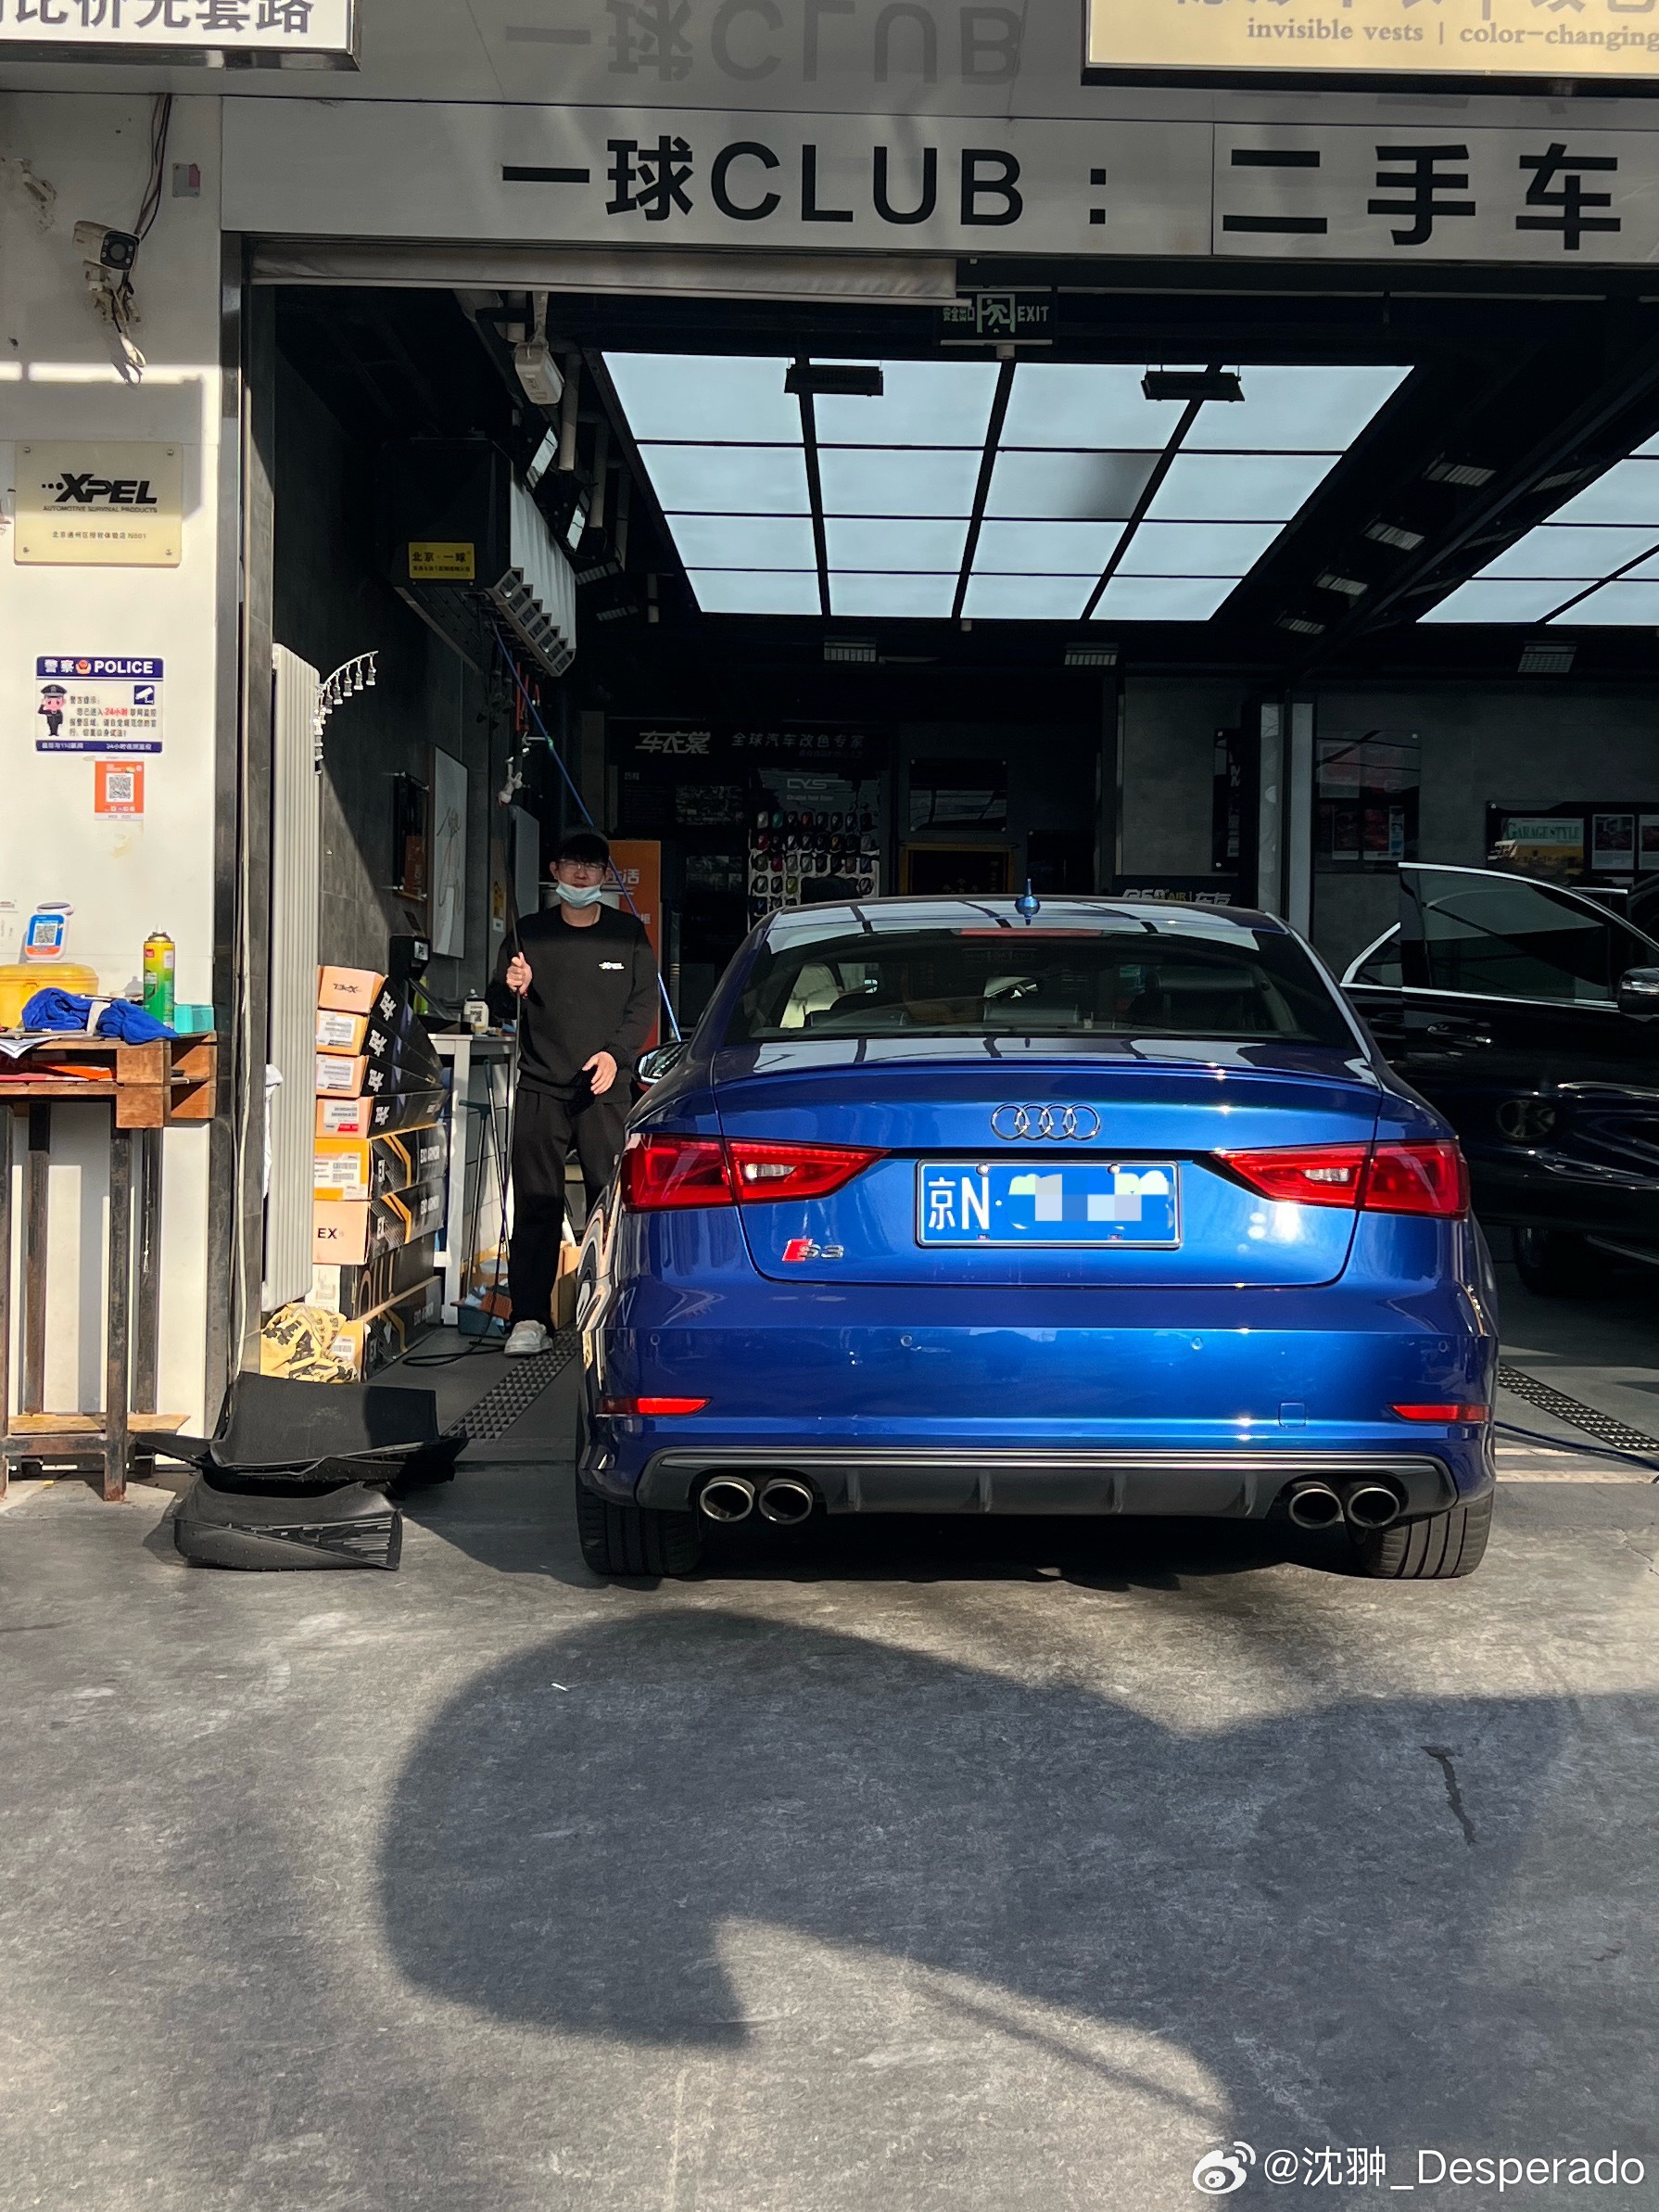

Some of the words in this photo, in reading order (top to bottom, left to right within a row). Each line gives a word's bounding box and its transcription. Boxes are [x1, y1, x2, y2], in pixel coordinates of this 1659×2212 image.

[1247, 18, 1353, 42] invisible
[1365, 24, 1424, 43] vests
[1017, 305, 1049, 323] EXIT
[54, 473, 158, 504] XPEL
[44, 659, 74, 673] 警察
[94, 660, 153, 674] POLICE
[634, 731, 712, 756] 车衣裳
[731, 731, 866, 750] 全球汽车改色专家
